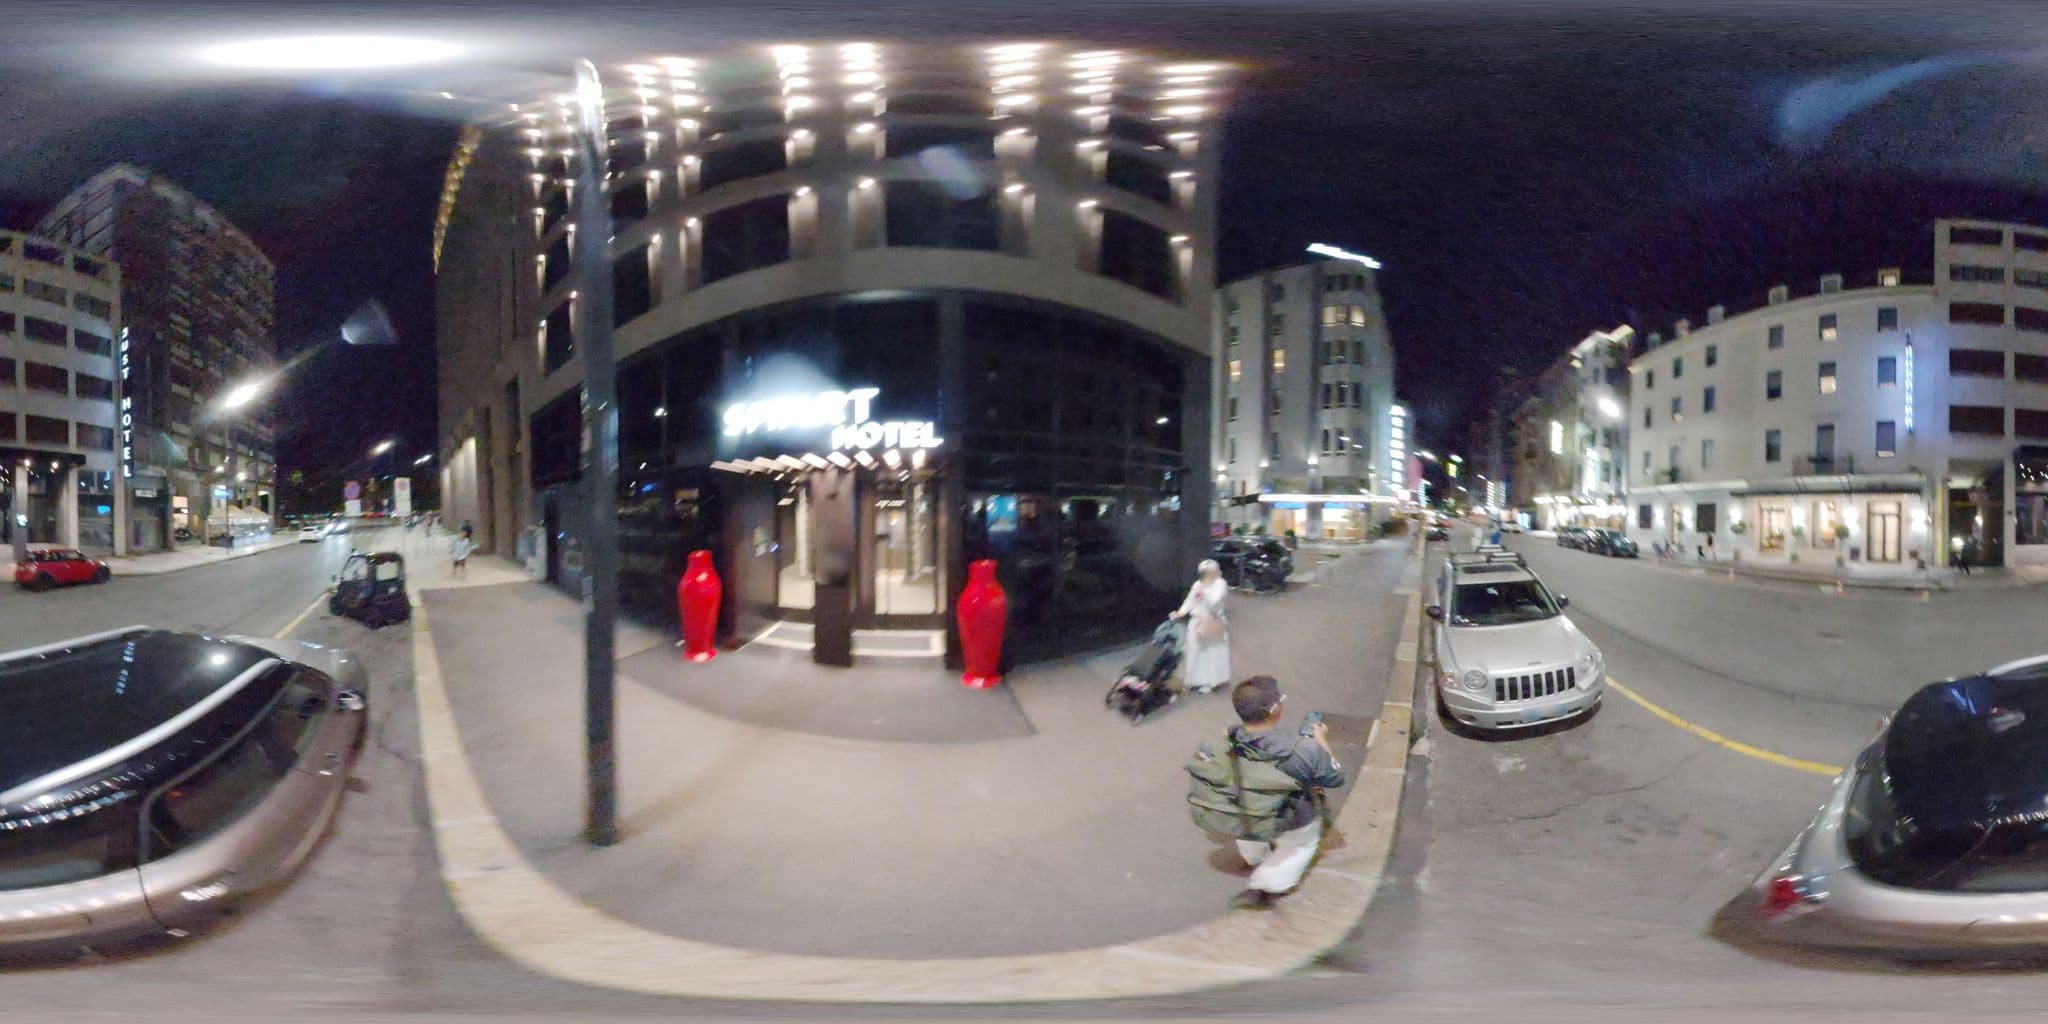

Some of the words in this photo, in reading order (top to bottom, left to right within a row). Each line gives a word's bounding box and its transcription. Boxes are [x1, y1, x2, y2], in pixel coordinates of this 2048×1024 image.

[121, 326, 130, 380] JUST
[122, 396, 132, 478] HOTEL
[831, 421, 945, 450] HOTEL
